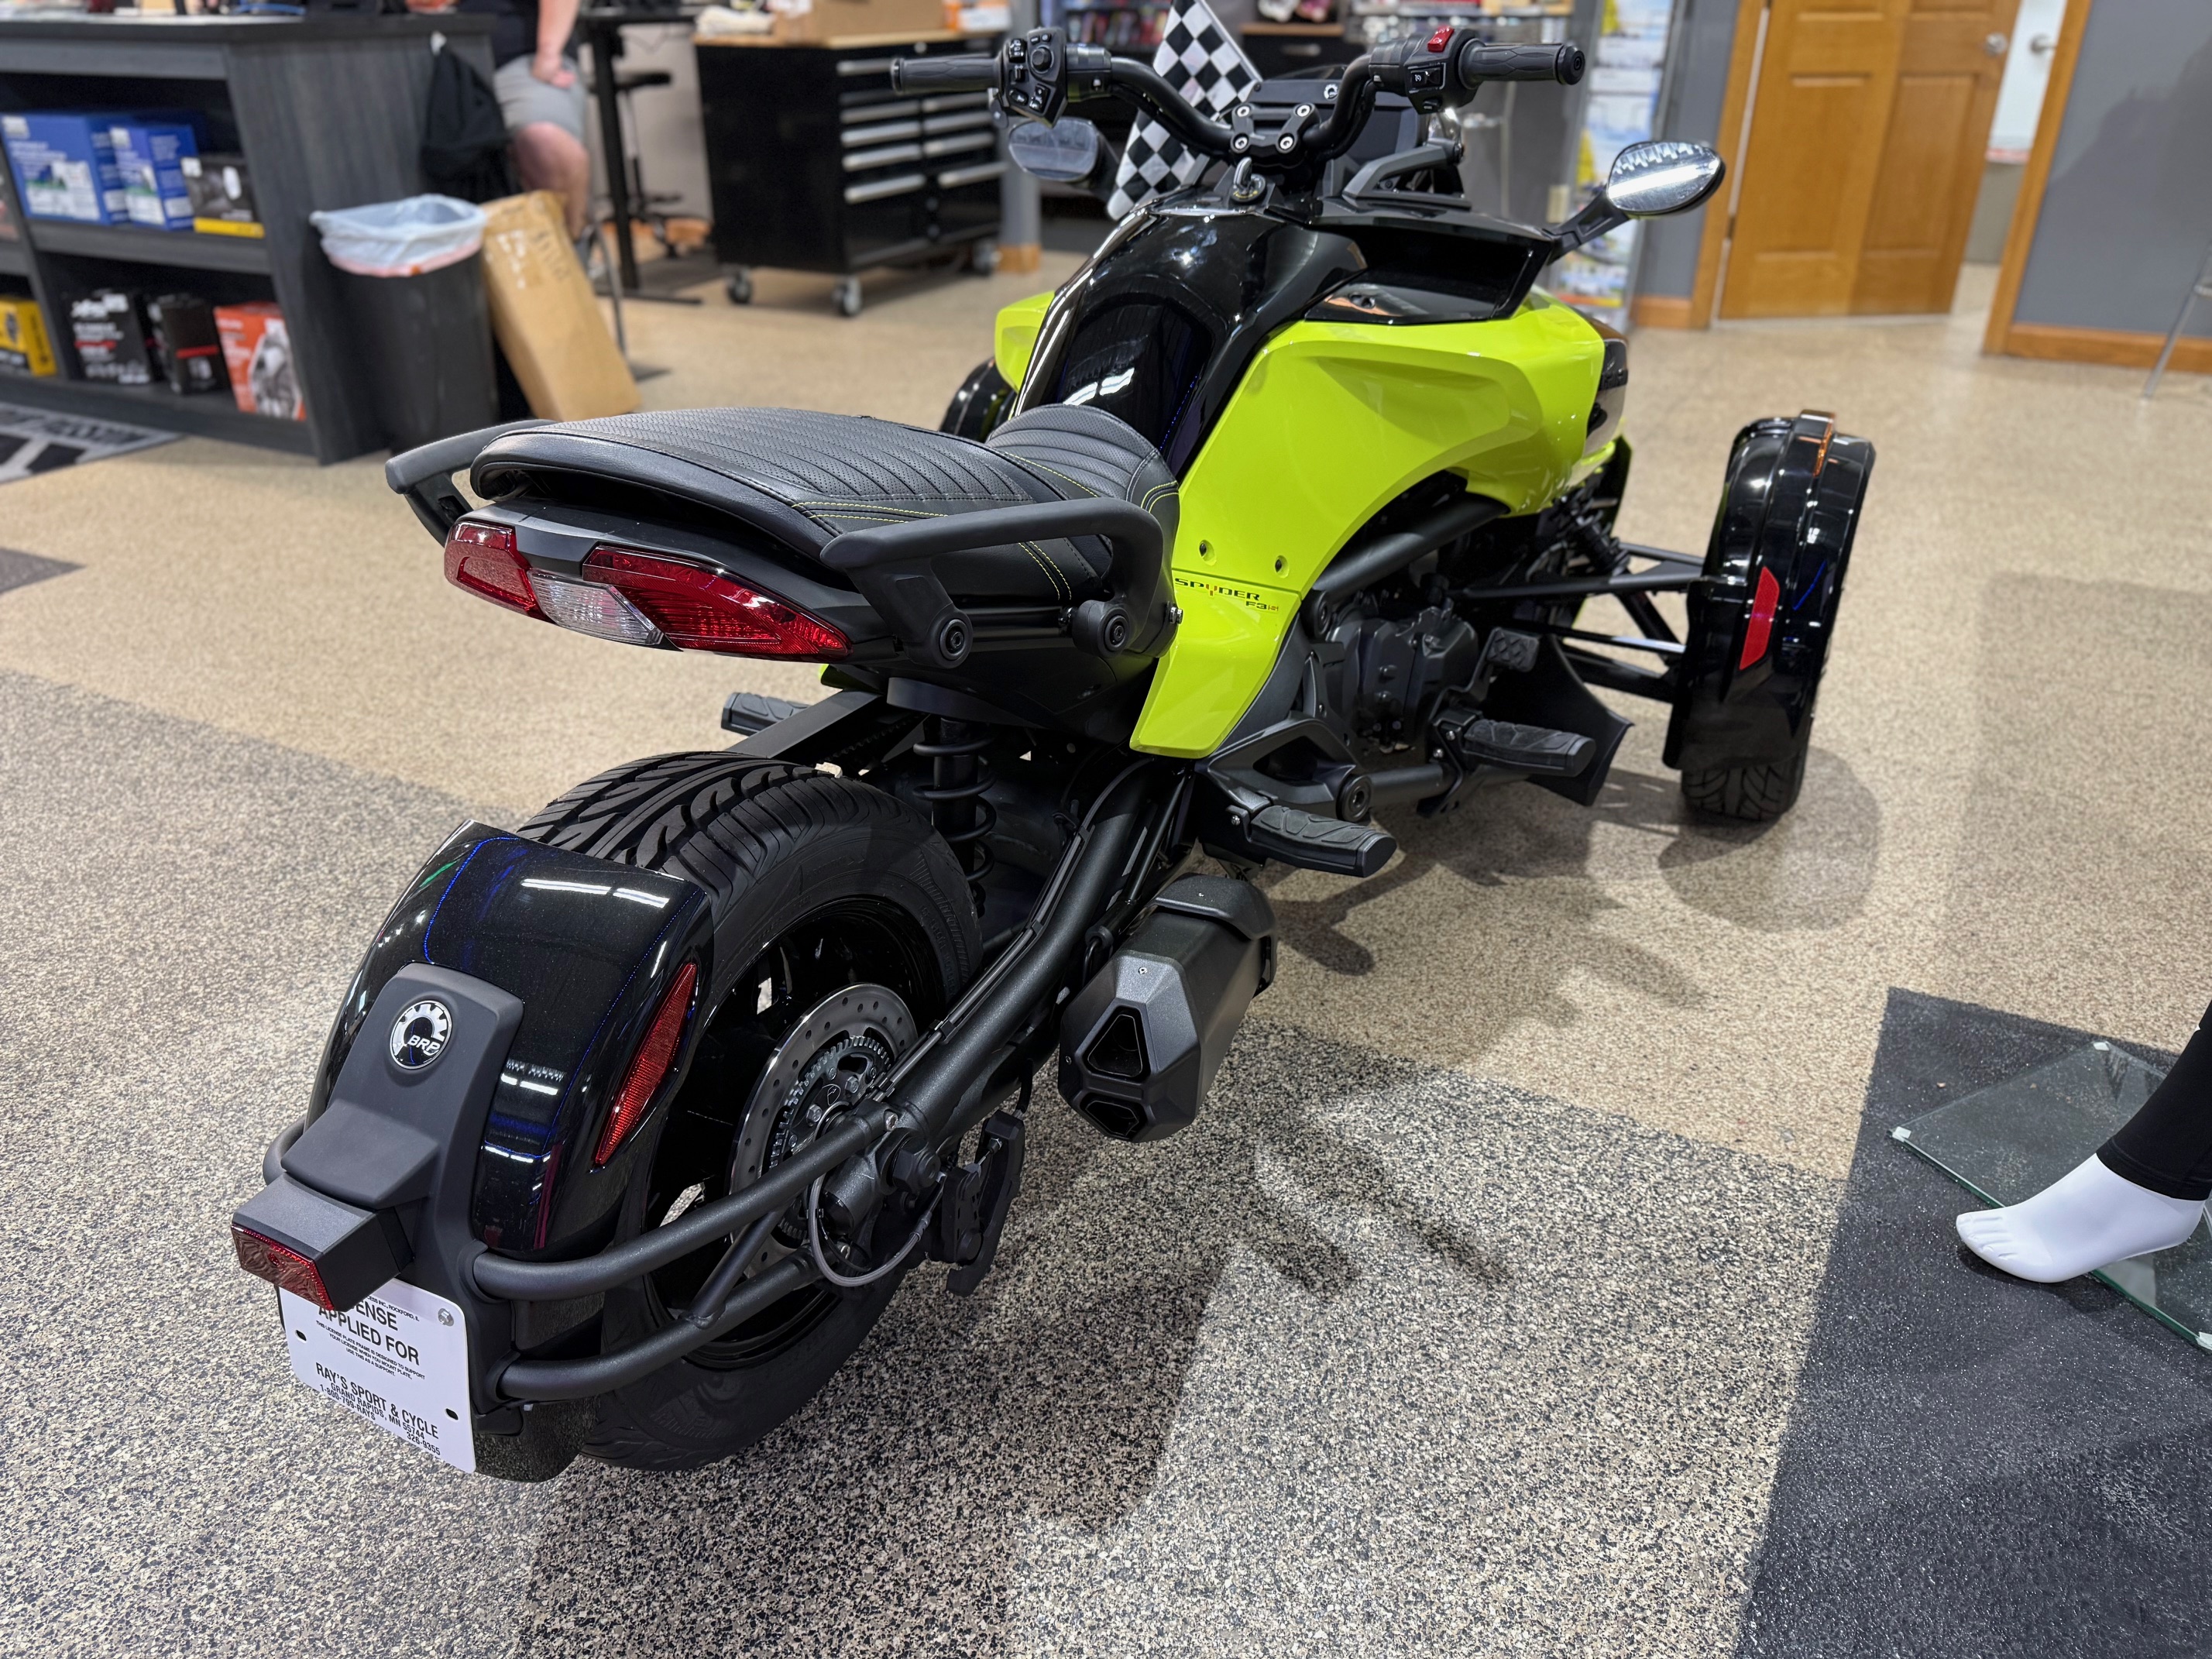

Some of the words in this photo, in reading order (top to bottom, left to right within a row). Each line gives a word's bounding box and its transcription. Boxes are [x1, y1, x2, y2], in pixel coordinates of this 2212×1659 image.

[1175, 578, 1260, 601] SPYDER
[407, 1034, 441, 1054] BRP
[356, 1300, 398, 1331] ENSE
[318, 1306, 382, 1346] APPLIED
[386, 1334, 420, 1365] FOR
[329, 1333, 341, 1342] YOUR
[381, 1360, 397, 1372] MOUNT
[345, 1347, 355, 1355] USE
[355, 1352, 364, 1360] THIS
[342, 1334, 356, 1345] PLATE
[376, 1352, 397, 1366] DESIGNED
[404, 1366, 425, 1379] SUPPORT
[315, 1362, 348, 1389] RAY'S
[350, 1382, 386, 1411] SPORT
[390, 1403, 399, 1418] &
[402, 1409, 439, 1439] CYCLE
[320, 1384, 376, 1420] 1-800-799-RAYS
[331, 1382, 356, 1402] GRAND
[388, 1414, 401, 1427] MN
[402, 1422, 425, 1440] 55744
[407, 1431, 441, 1455] 326-9355
